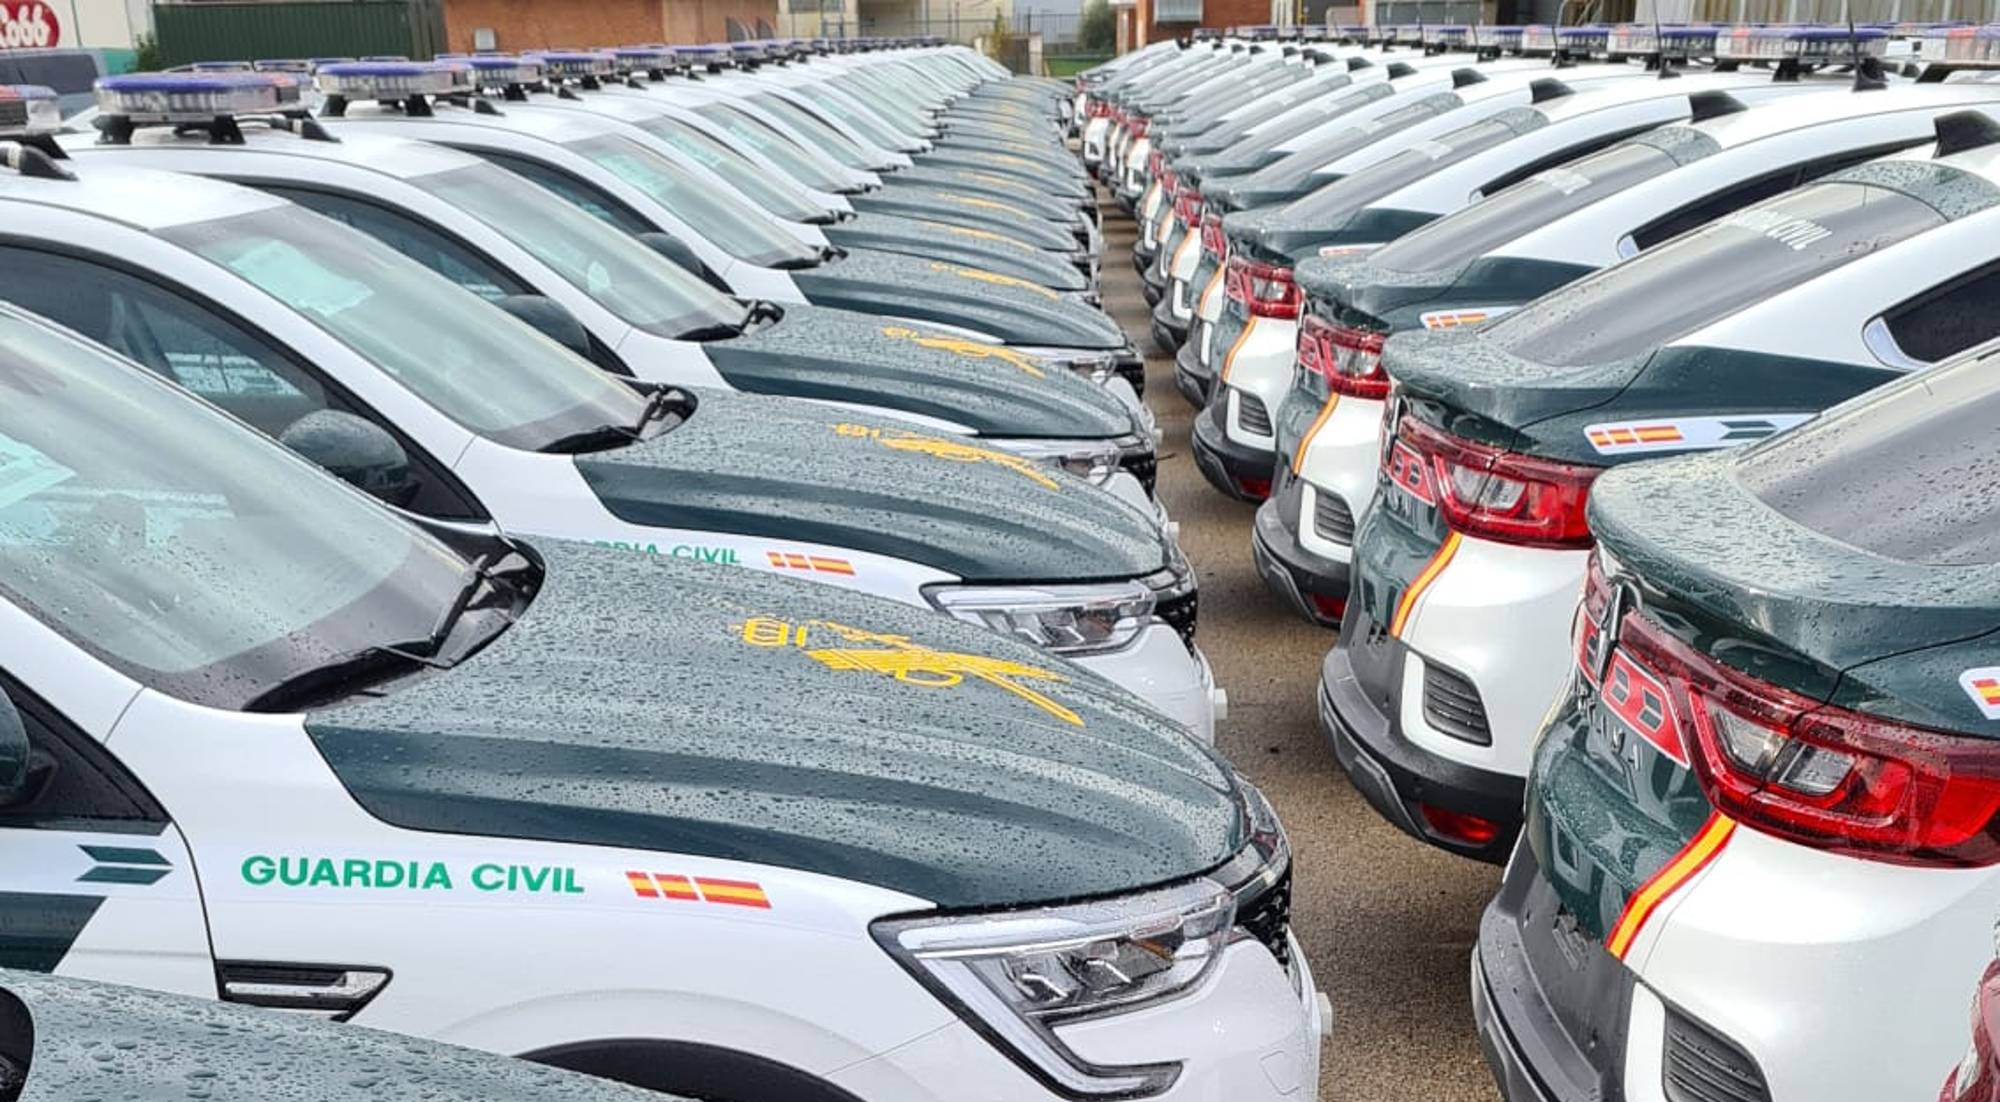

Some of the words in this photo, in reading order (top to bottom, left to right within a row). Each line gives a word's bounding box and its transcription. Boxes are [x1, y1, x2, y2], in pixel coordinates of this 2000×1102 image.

[672, 544, 740, 564] CIVIL
[240, 855, 453, 889] GUARDIA
[471, 864, 584, 893] CIVIL
